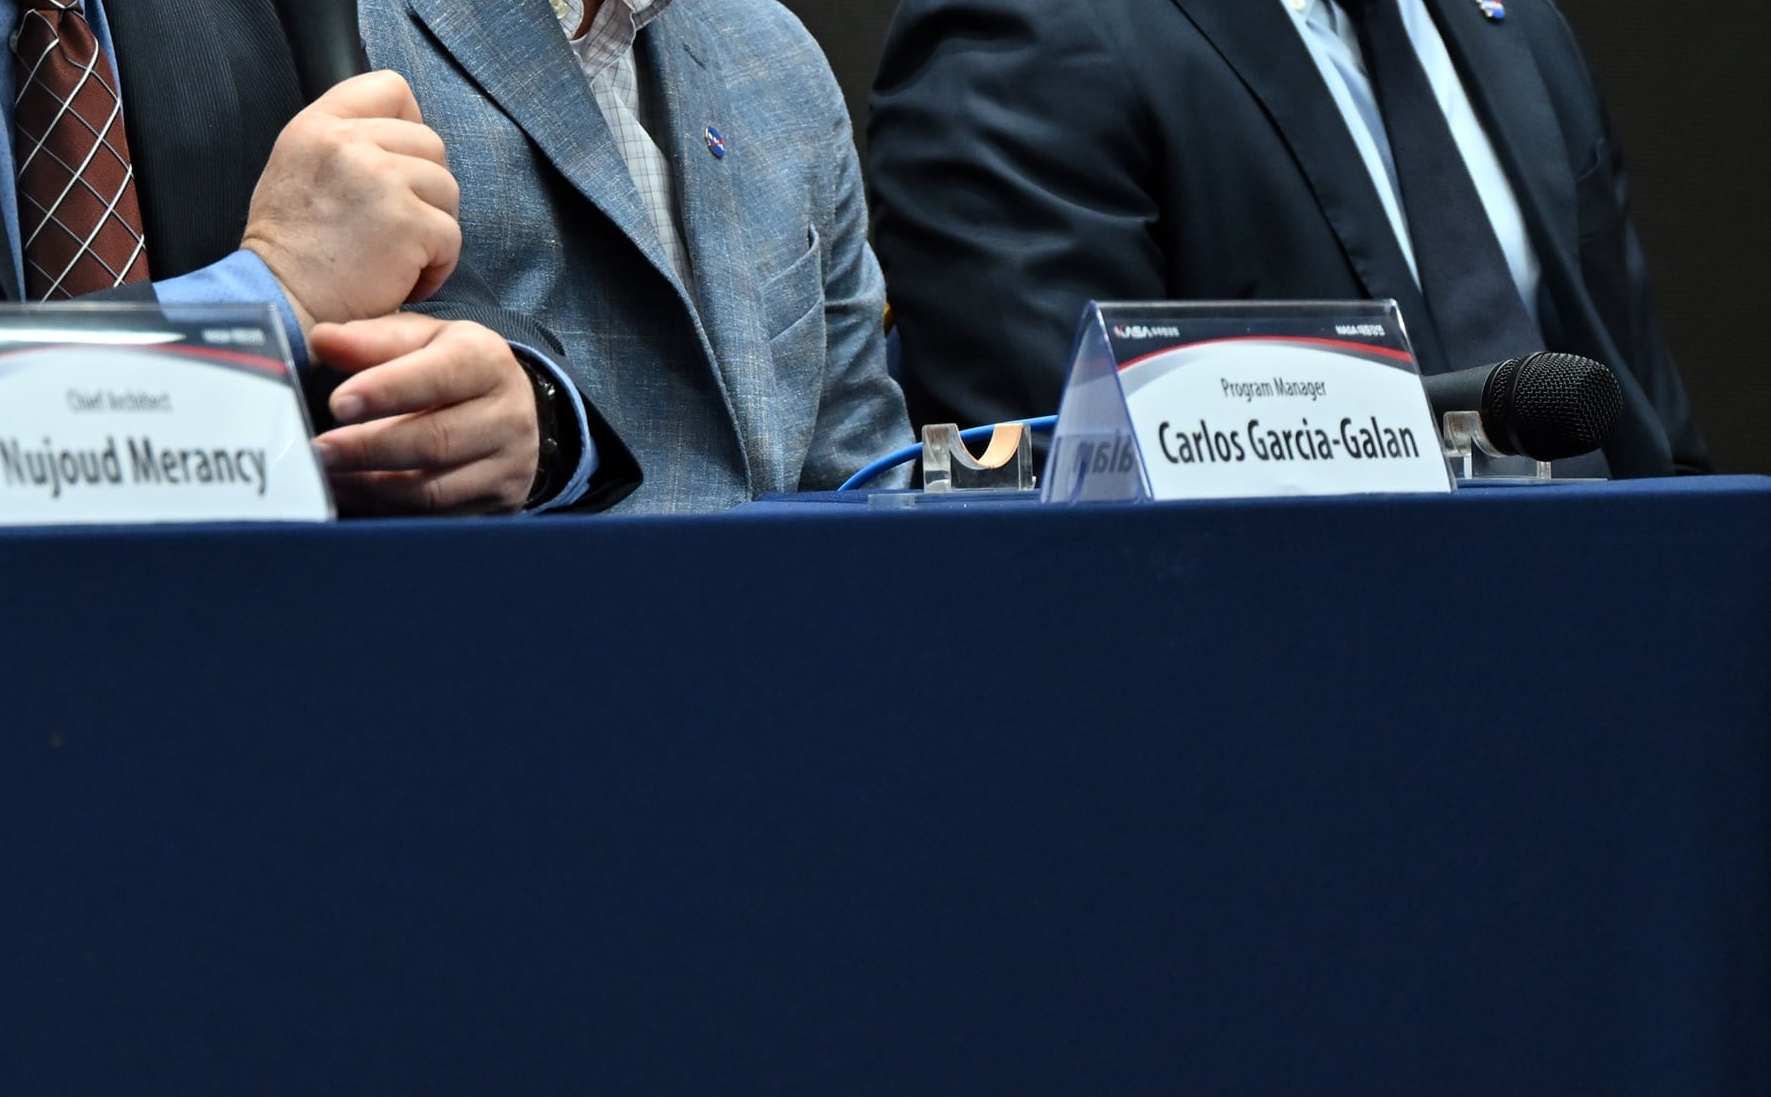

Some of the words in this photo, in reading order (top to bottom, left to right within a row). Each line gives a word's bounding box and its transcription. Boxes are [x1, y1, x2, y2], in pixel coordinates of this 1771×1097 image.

[1220, 377, 1274, 402] Program
[1273, 377, 1326, 401] Manager
[1158, 419, 1245, 464] Carlos
[1246, 416, 1420, 461] Garcia-Galan
[126, 436, 266, 496] Merancy
